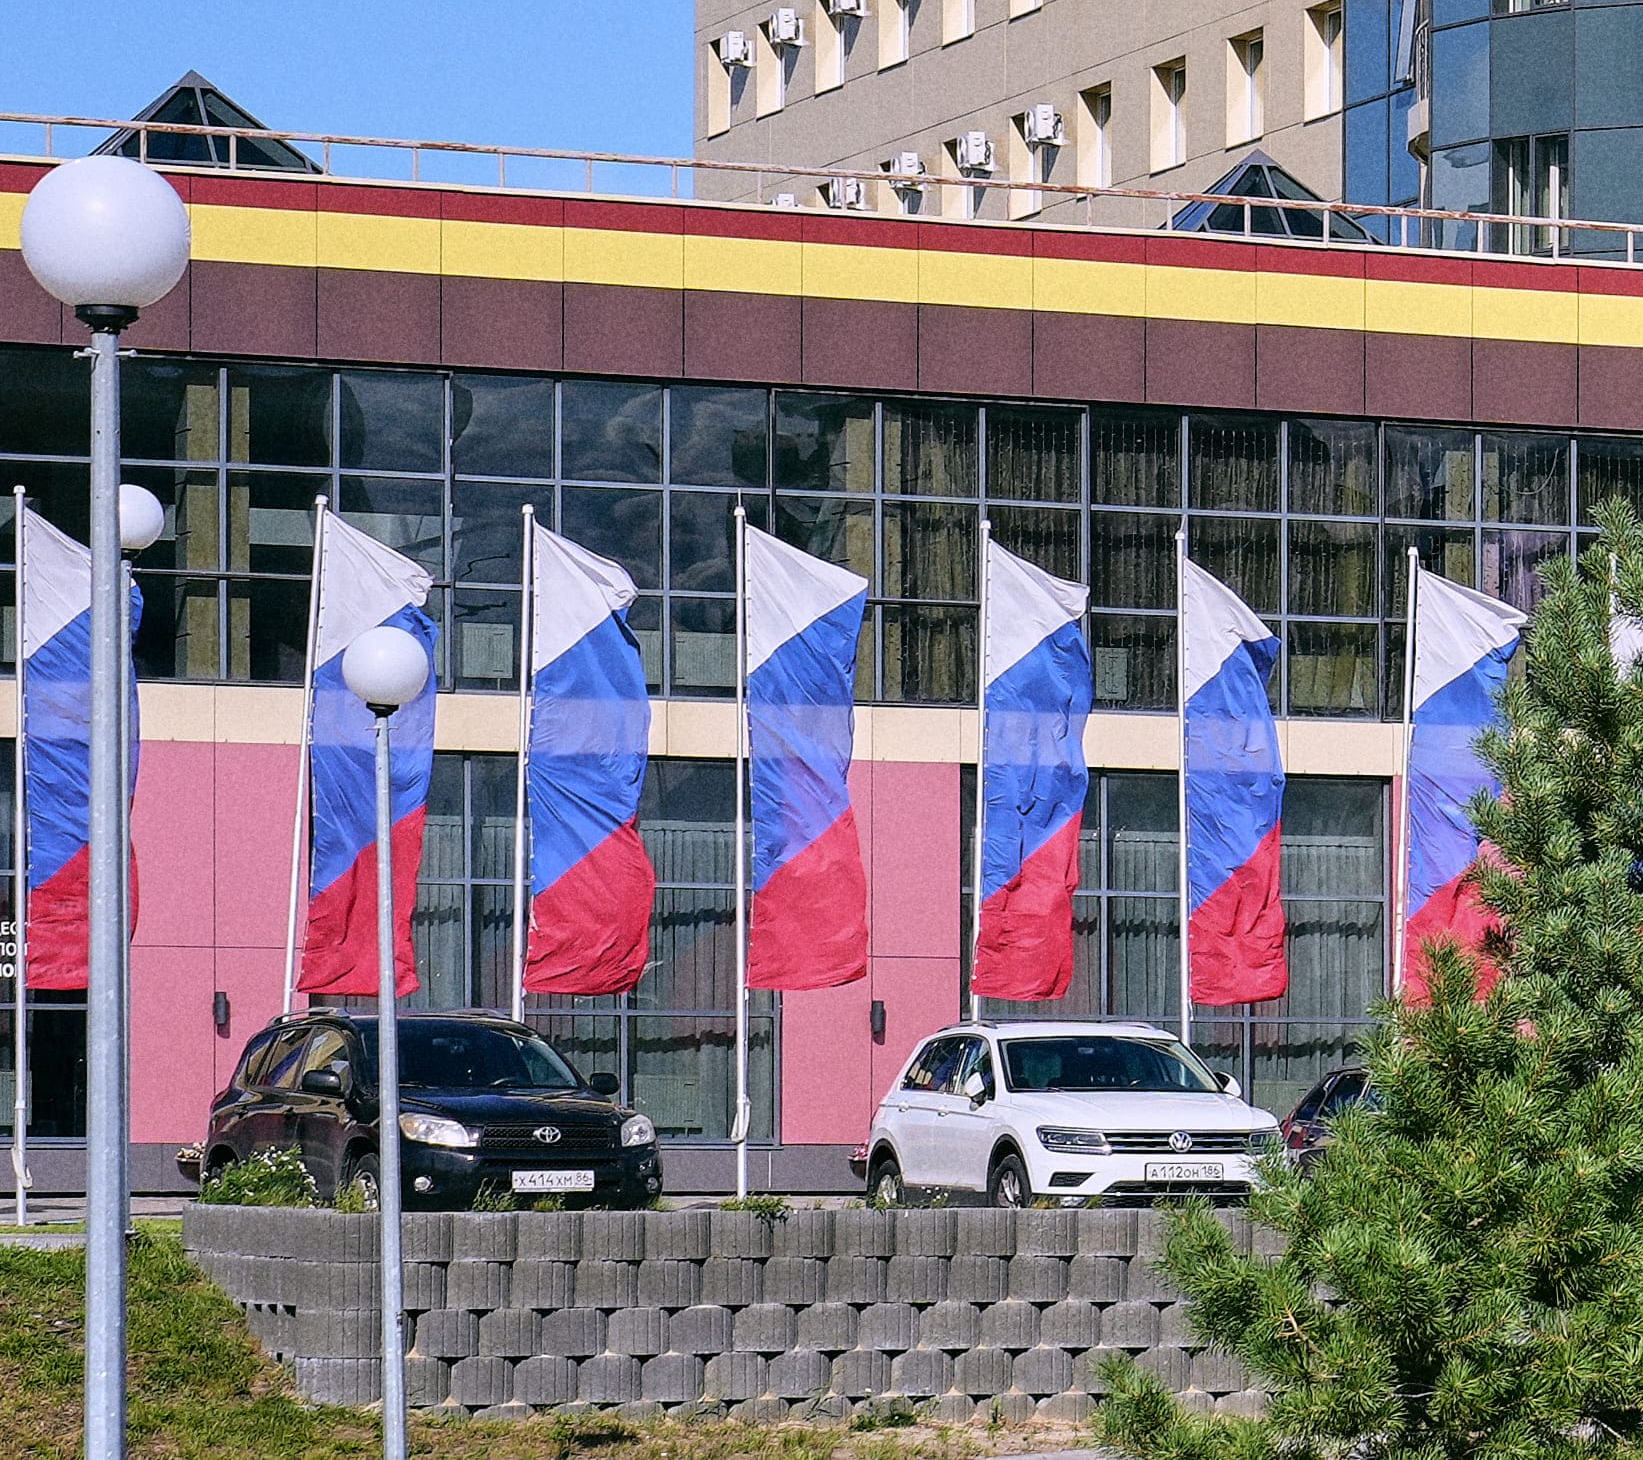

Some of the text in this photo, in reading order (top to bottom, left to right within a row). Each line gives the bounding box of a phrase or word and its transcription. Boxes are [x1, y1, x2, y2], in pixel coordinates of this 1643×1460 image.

[1151, 1165, 1220, 1179] А112ОН 186
[519, 1173, 588, 1186] Х414ХМ 86
